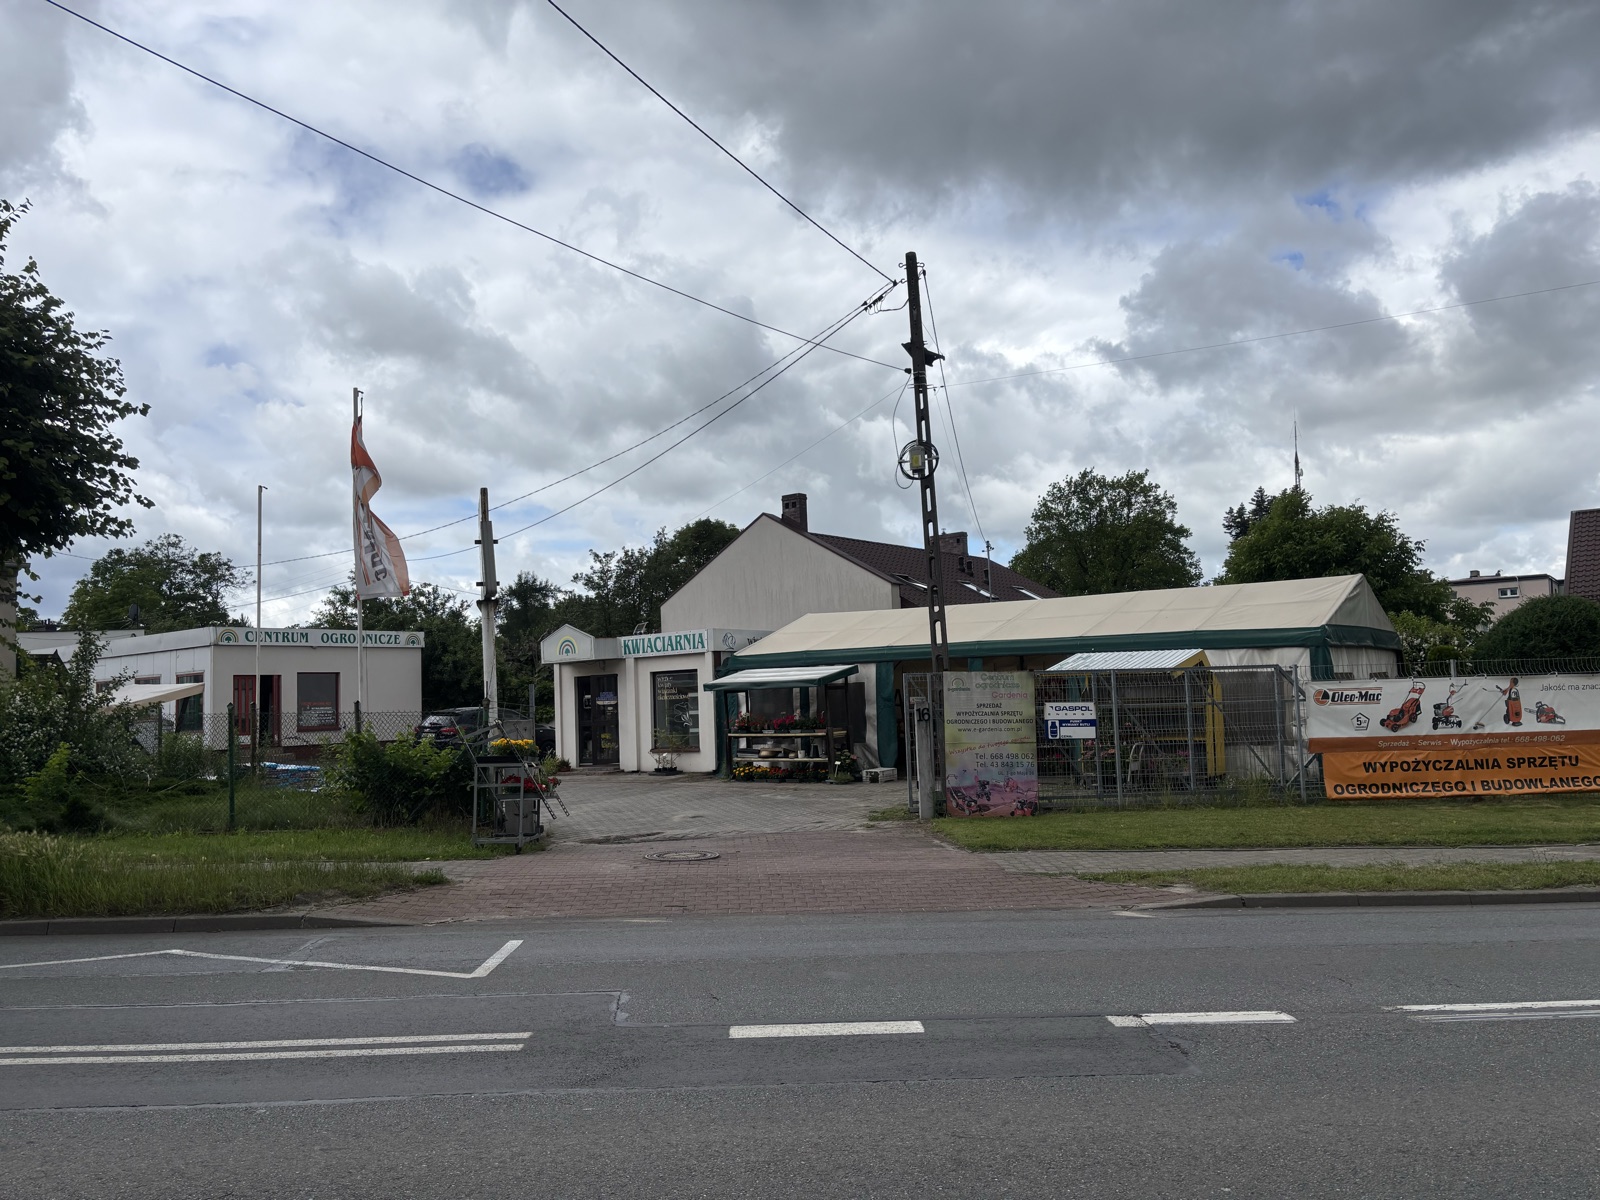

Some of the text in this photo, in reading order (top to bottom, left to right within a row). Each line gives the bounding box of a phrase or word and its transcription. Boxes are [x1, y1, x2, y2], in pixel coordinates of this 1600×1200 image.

[244, 630, 309, 643] CENTRUM
[623, 633, 706, 655] KWIACIARNIA
[980, 673, 1015, 681] Centrum
[1540, 683, 1566, 691] Jakość
[991, 691, 1028, 699] Gardenia
[1330, 690, 1382, 703] Oleo-Mac
[916, 707, 931, 722] 16
[1356, 716, 1362, 726] 5
[1378, 740, 1410, 748] Sprzedaż
[1450, 737, 1499, 747] Wypożyczalnia
[1515, 734, 1566, 743] 668-498-062
[975, 752, 1035, 760] Tel. 668 498 062
[1363, 754, 1580, 774] WYPOŻYCZALNIA SPRZĘTU
[1333, 780, 1467, 796] OGRODNICZEGO
[1471, 781, 1477, 792] I
